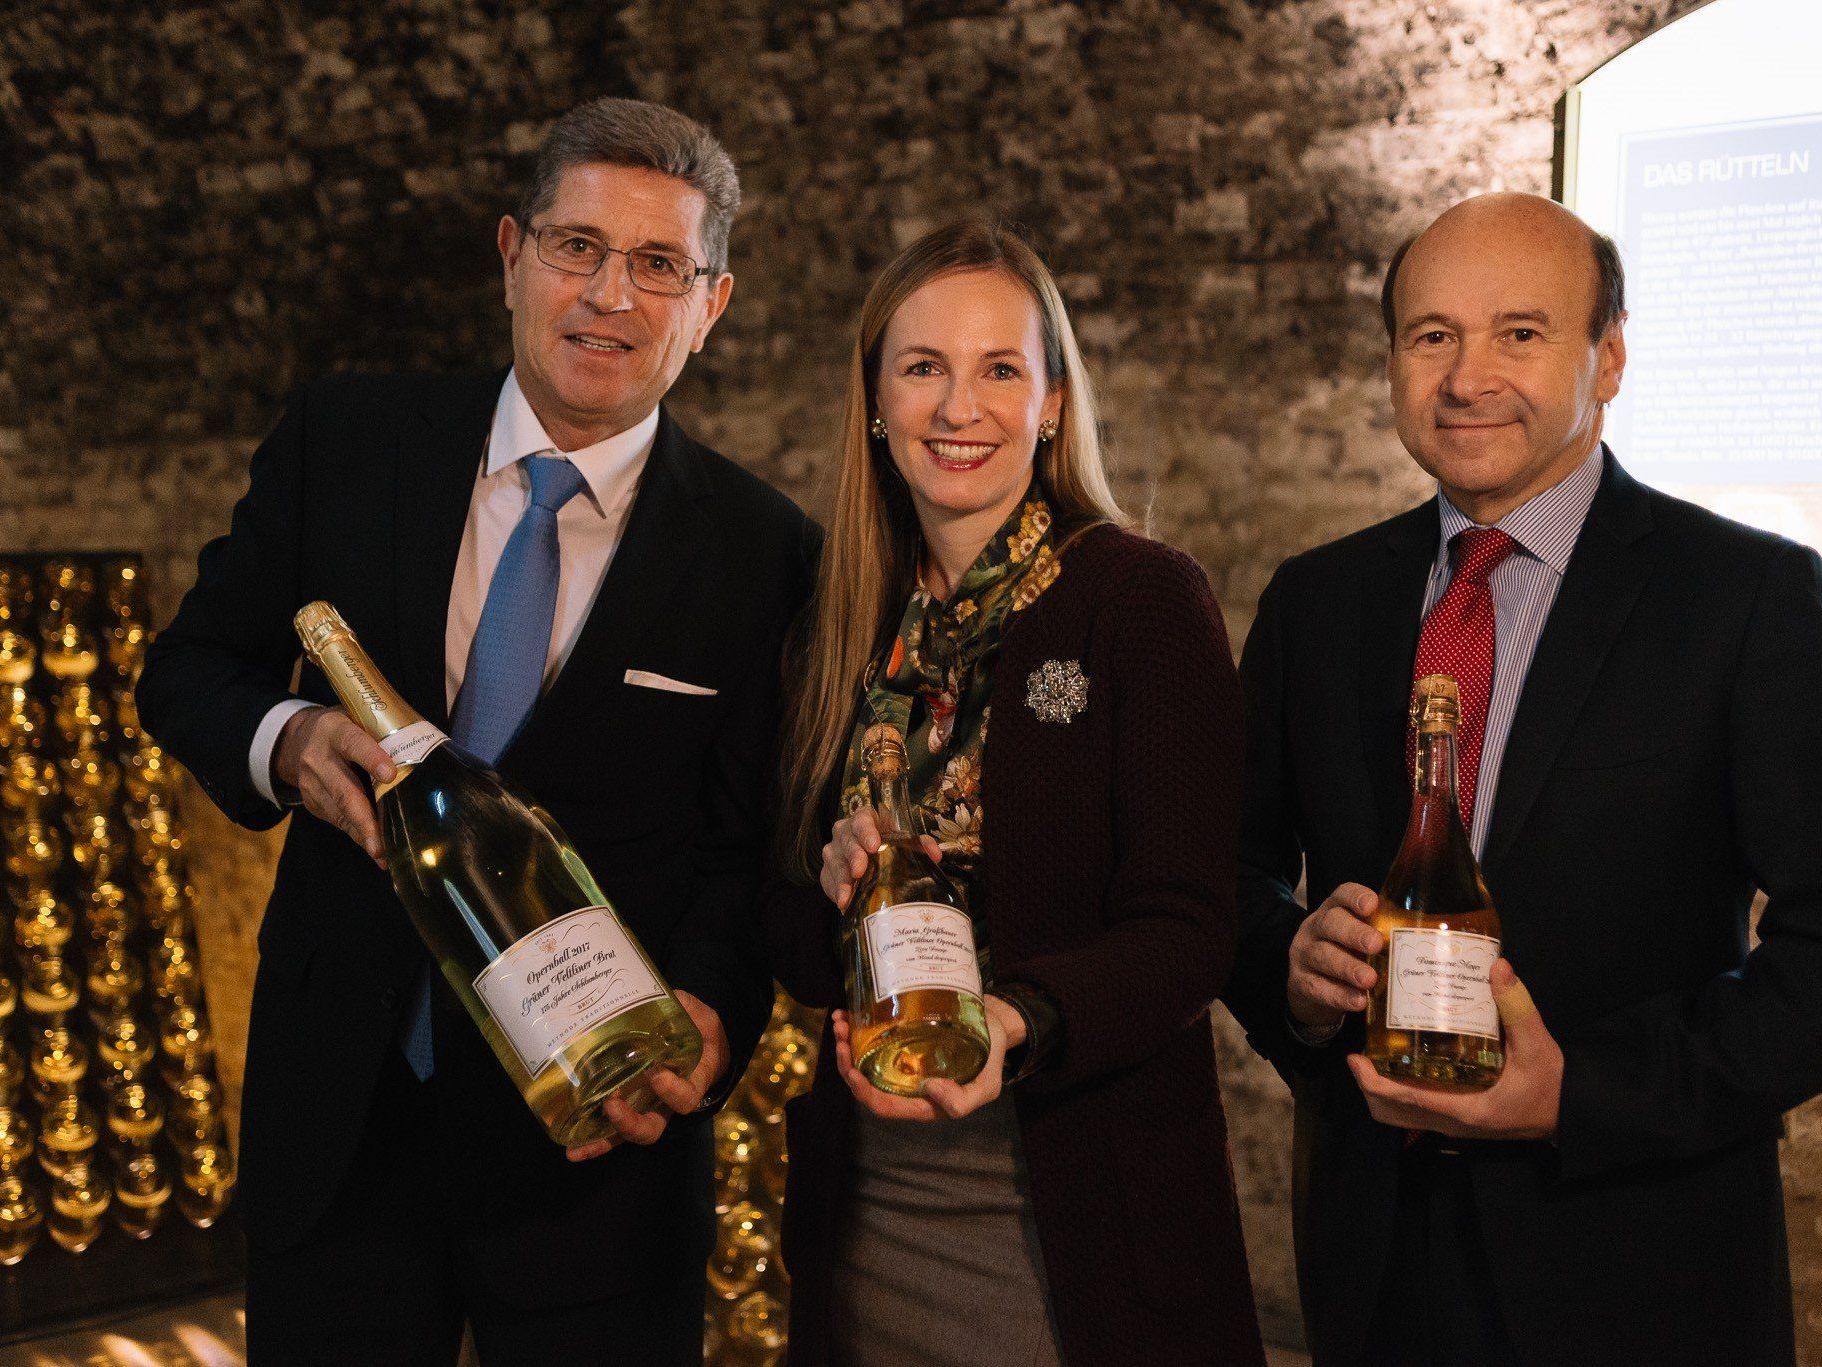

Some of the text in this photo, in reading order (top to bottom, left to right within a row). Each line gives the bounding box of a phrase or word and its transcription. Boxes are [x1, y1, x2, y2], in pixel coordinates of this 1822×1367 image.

[1643, 149, 1810, 189] DAS RÜTTELN
[338, 650, 388, 711] Schlumberger
[894, 928, 919, 938] Maria
[521, 949, 617, 1017] Grüner Veltliner Brut
[526, 942, 591, 985] Opernball 2017
[540, 967, 613, 1015] 175 Jahre Schlumberger
[577, 996, 595, 1010] BRUT
